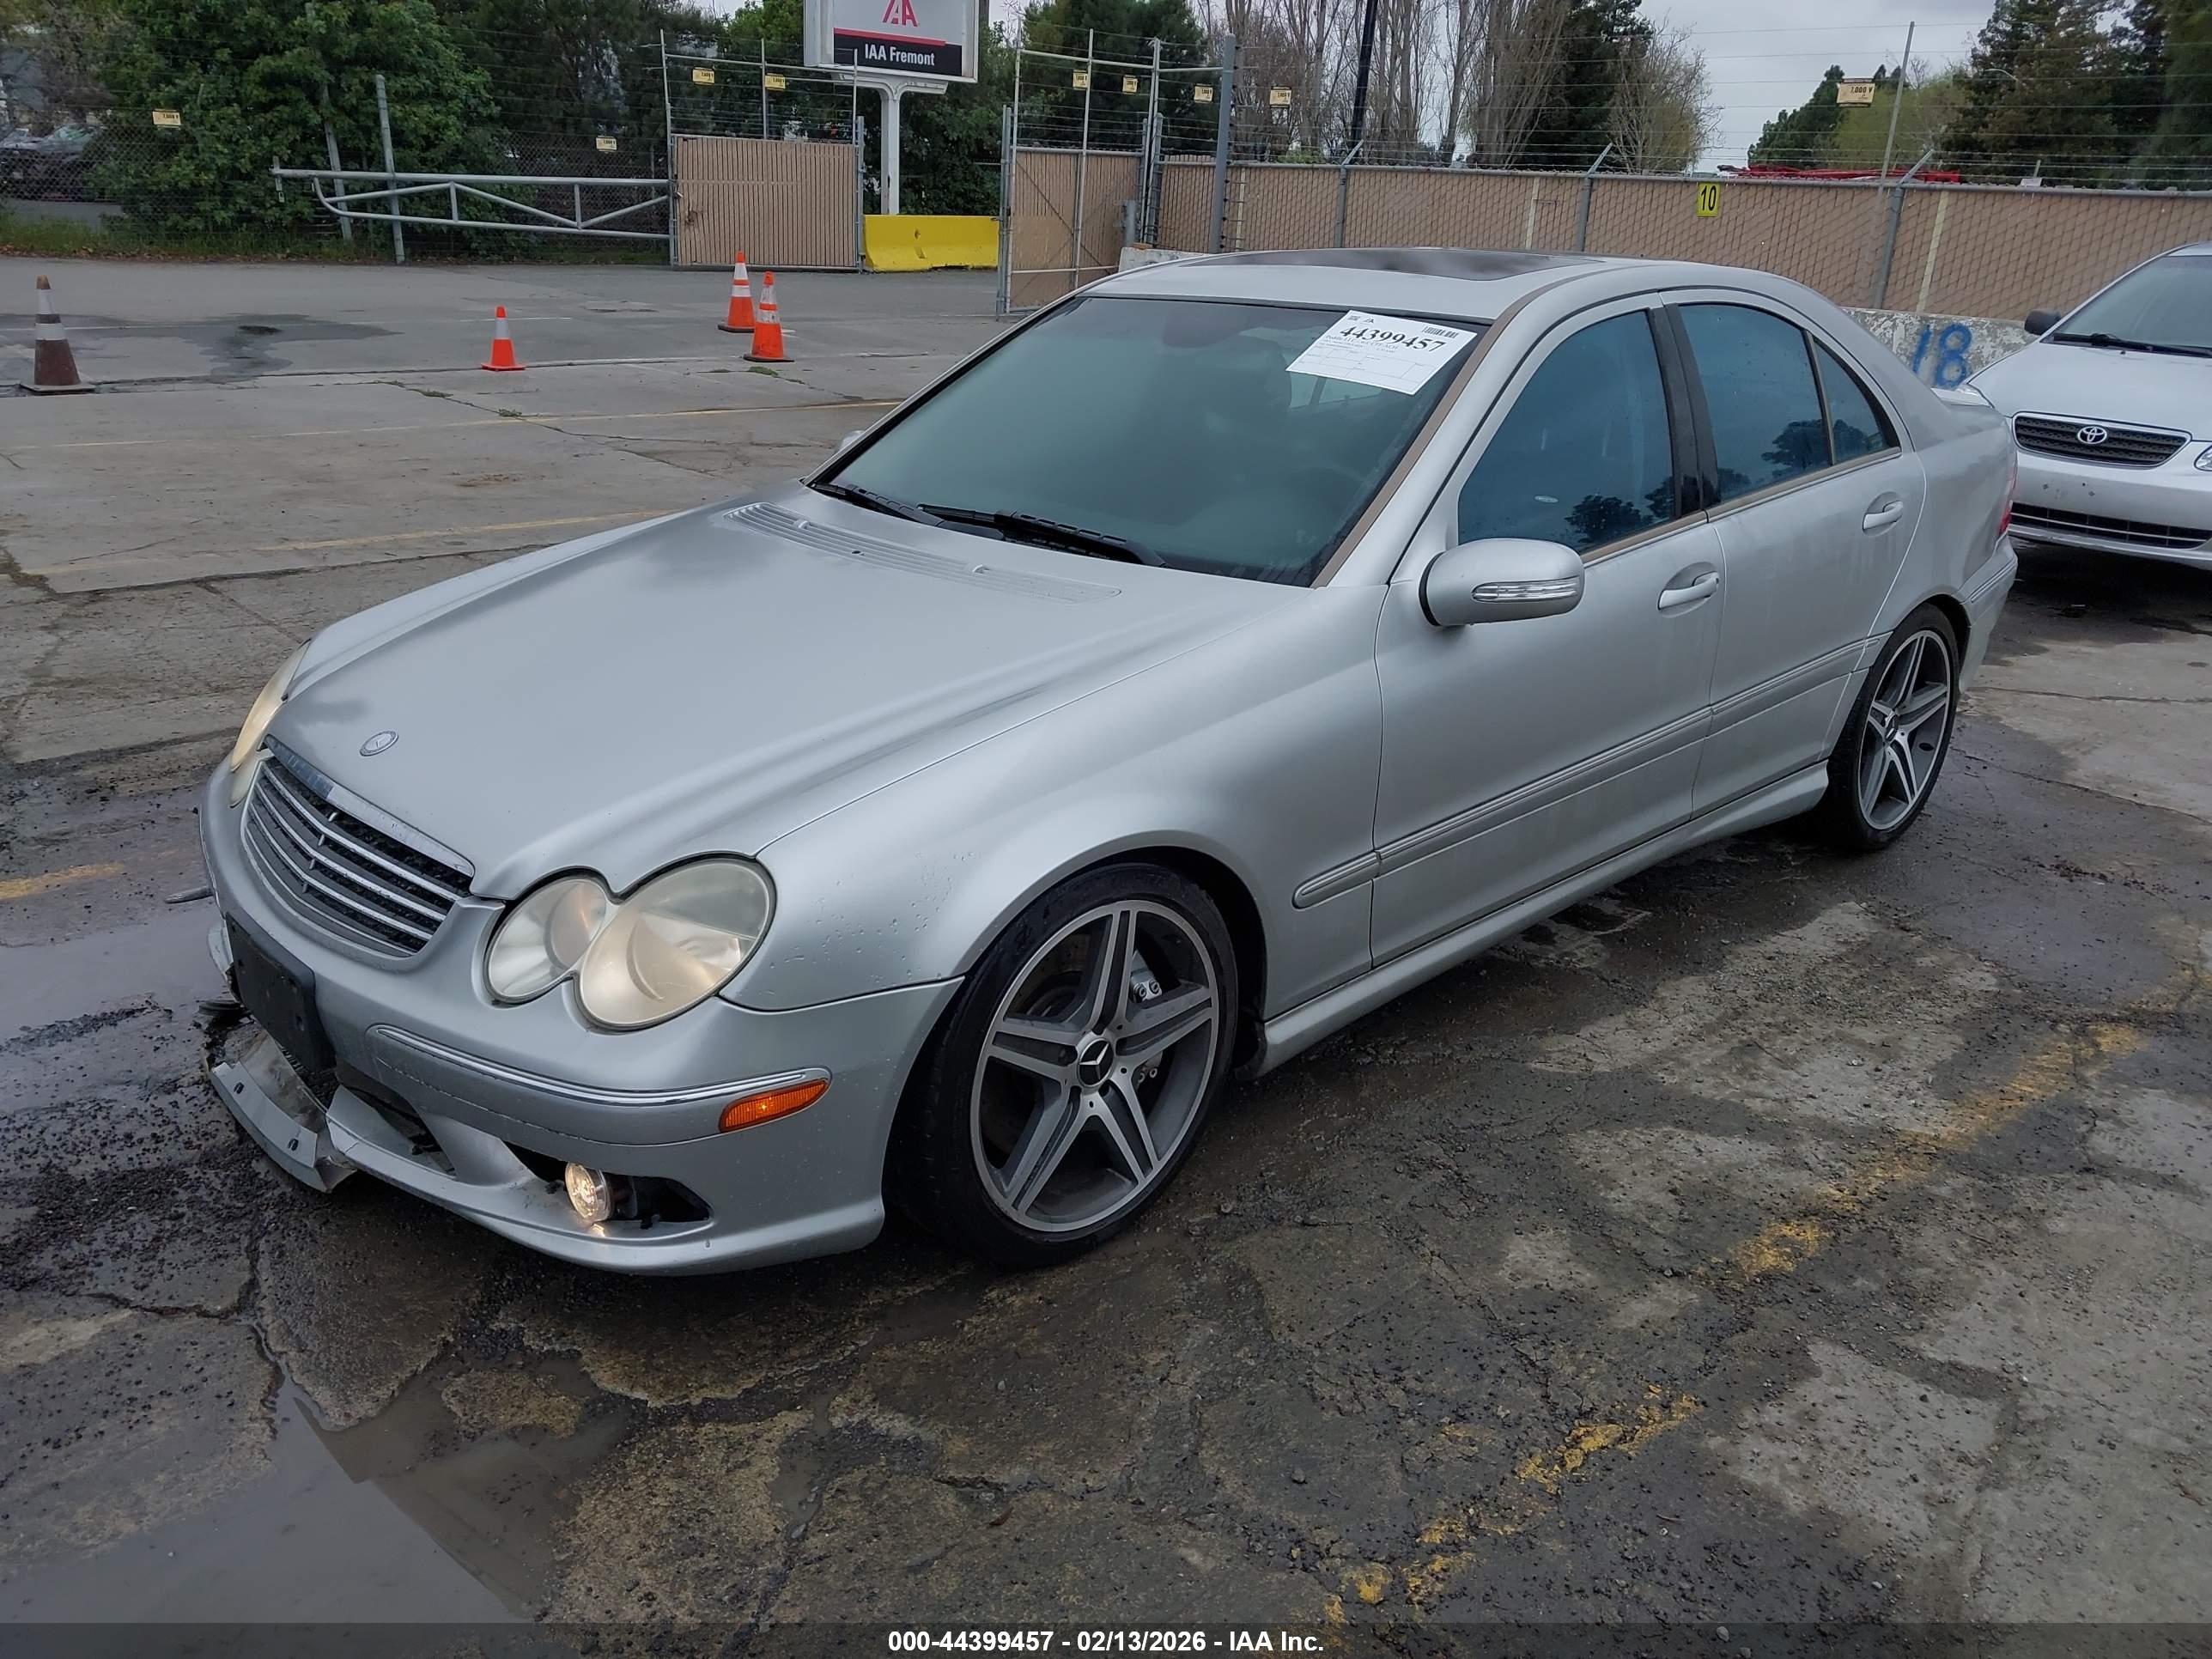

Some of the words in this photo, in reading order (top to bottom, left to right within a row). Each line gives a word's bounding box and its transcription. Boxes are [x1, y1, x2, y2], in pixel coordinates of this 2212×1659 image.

[865, 43, 887, 61] IAA
[890, 46, 935, 66] Fremont
[1700, 185, 1717, 211] 10
[1340, 325, 1446, 352] 44399457
[1911, 323, 1972, 390] 18
